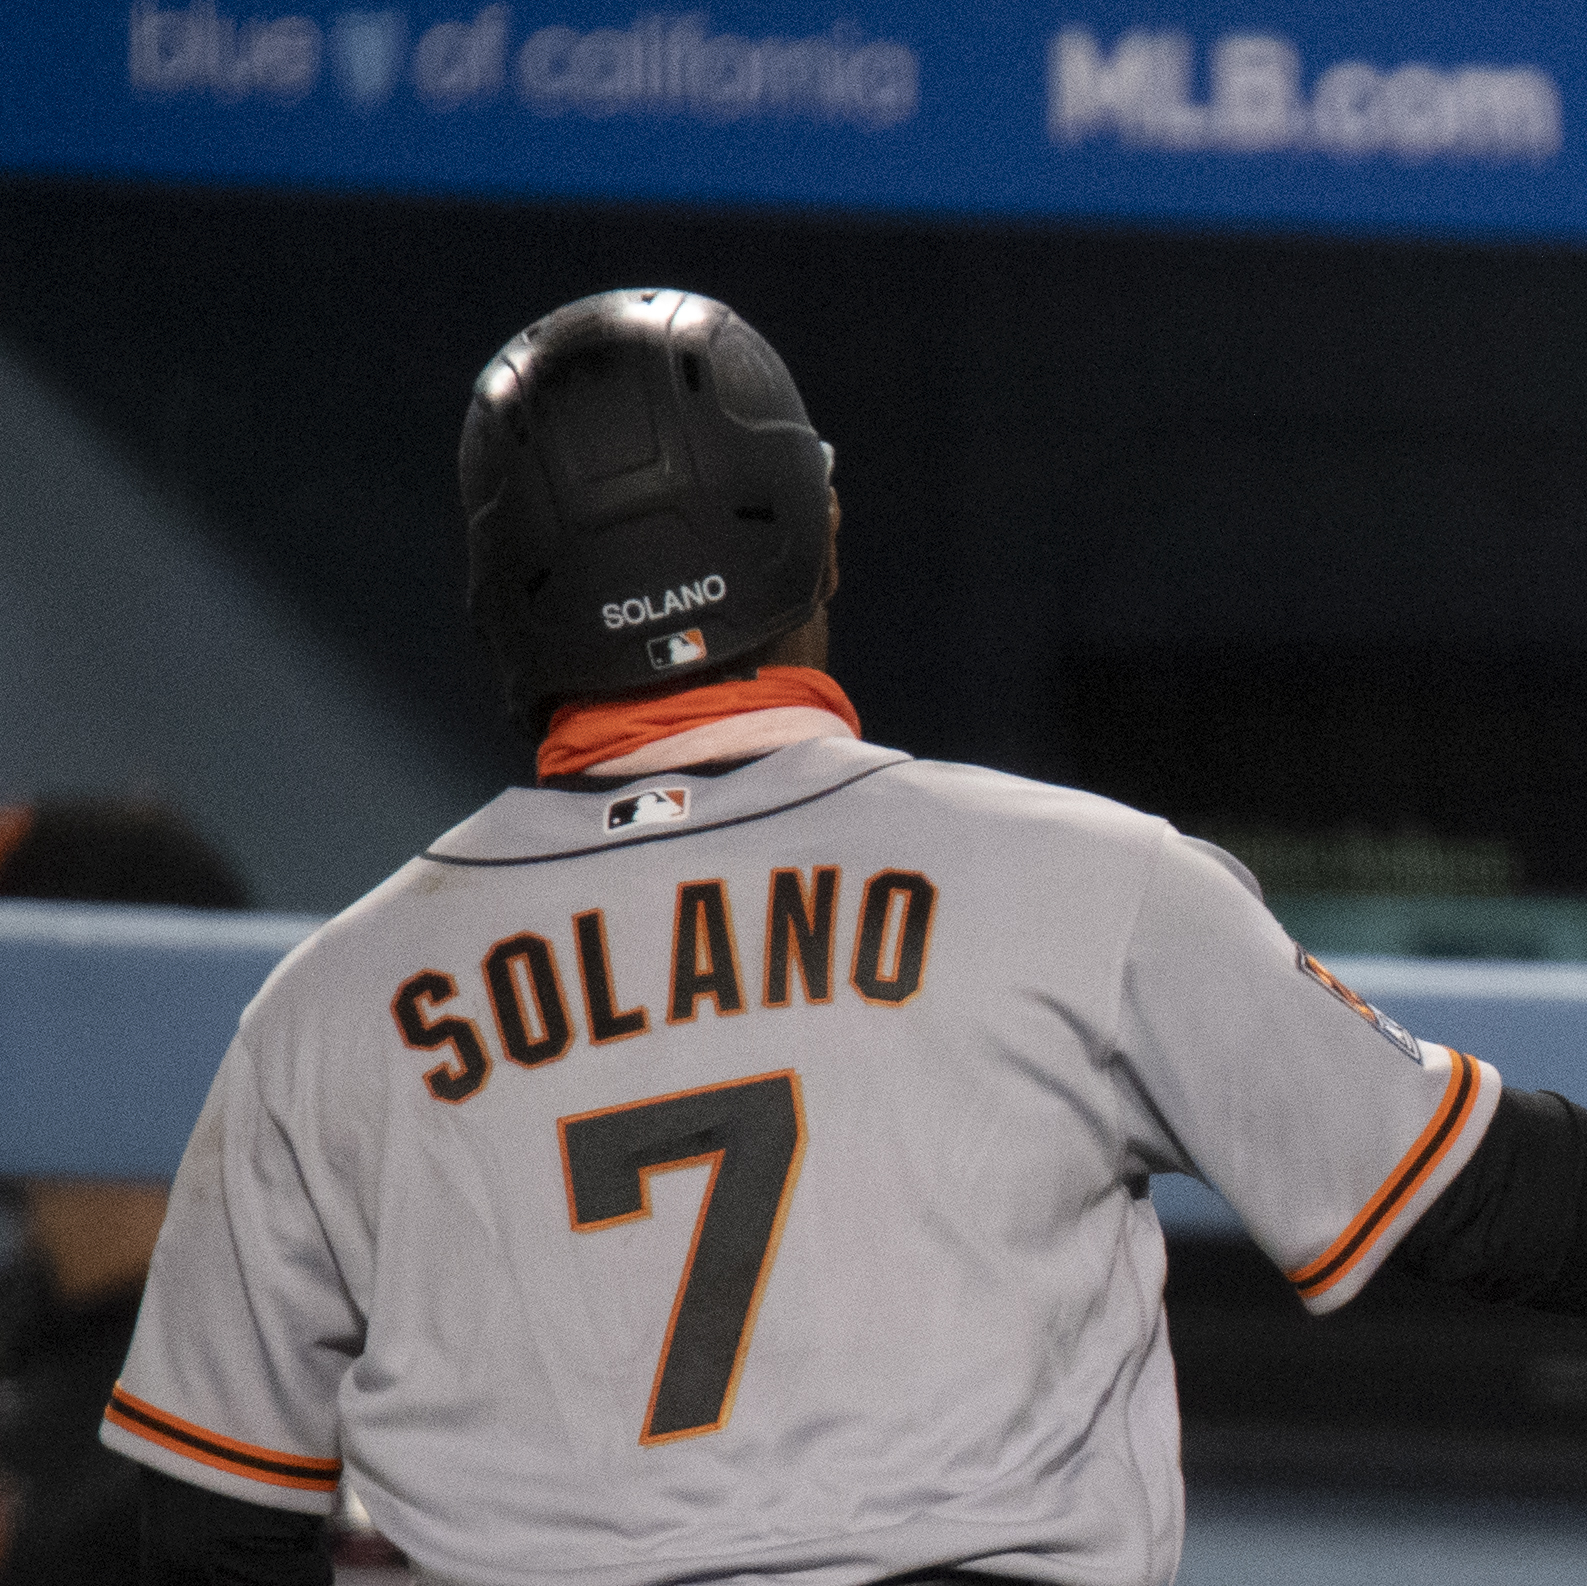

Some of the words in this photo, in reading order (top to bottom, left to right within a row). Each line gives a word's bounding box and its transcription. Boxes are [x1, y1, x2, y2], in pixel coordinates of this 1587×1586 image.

[518, 14, 920, 129] california
[1047, 27, 1561, 159] MLB.com
[602, 574, 727, 630] SOLANO
[390, 865, 940, 1105] SOLANO
[557, 1068, 808, 1446] 7
